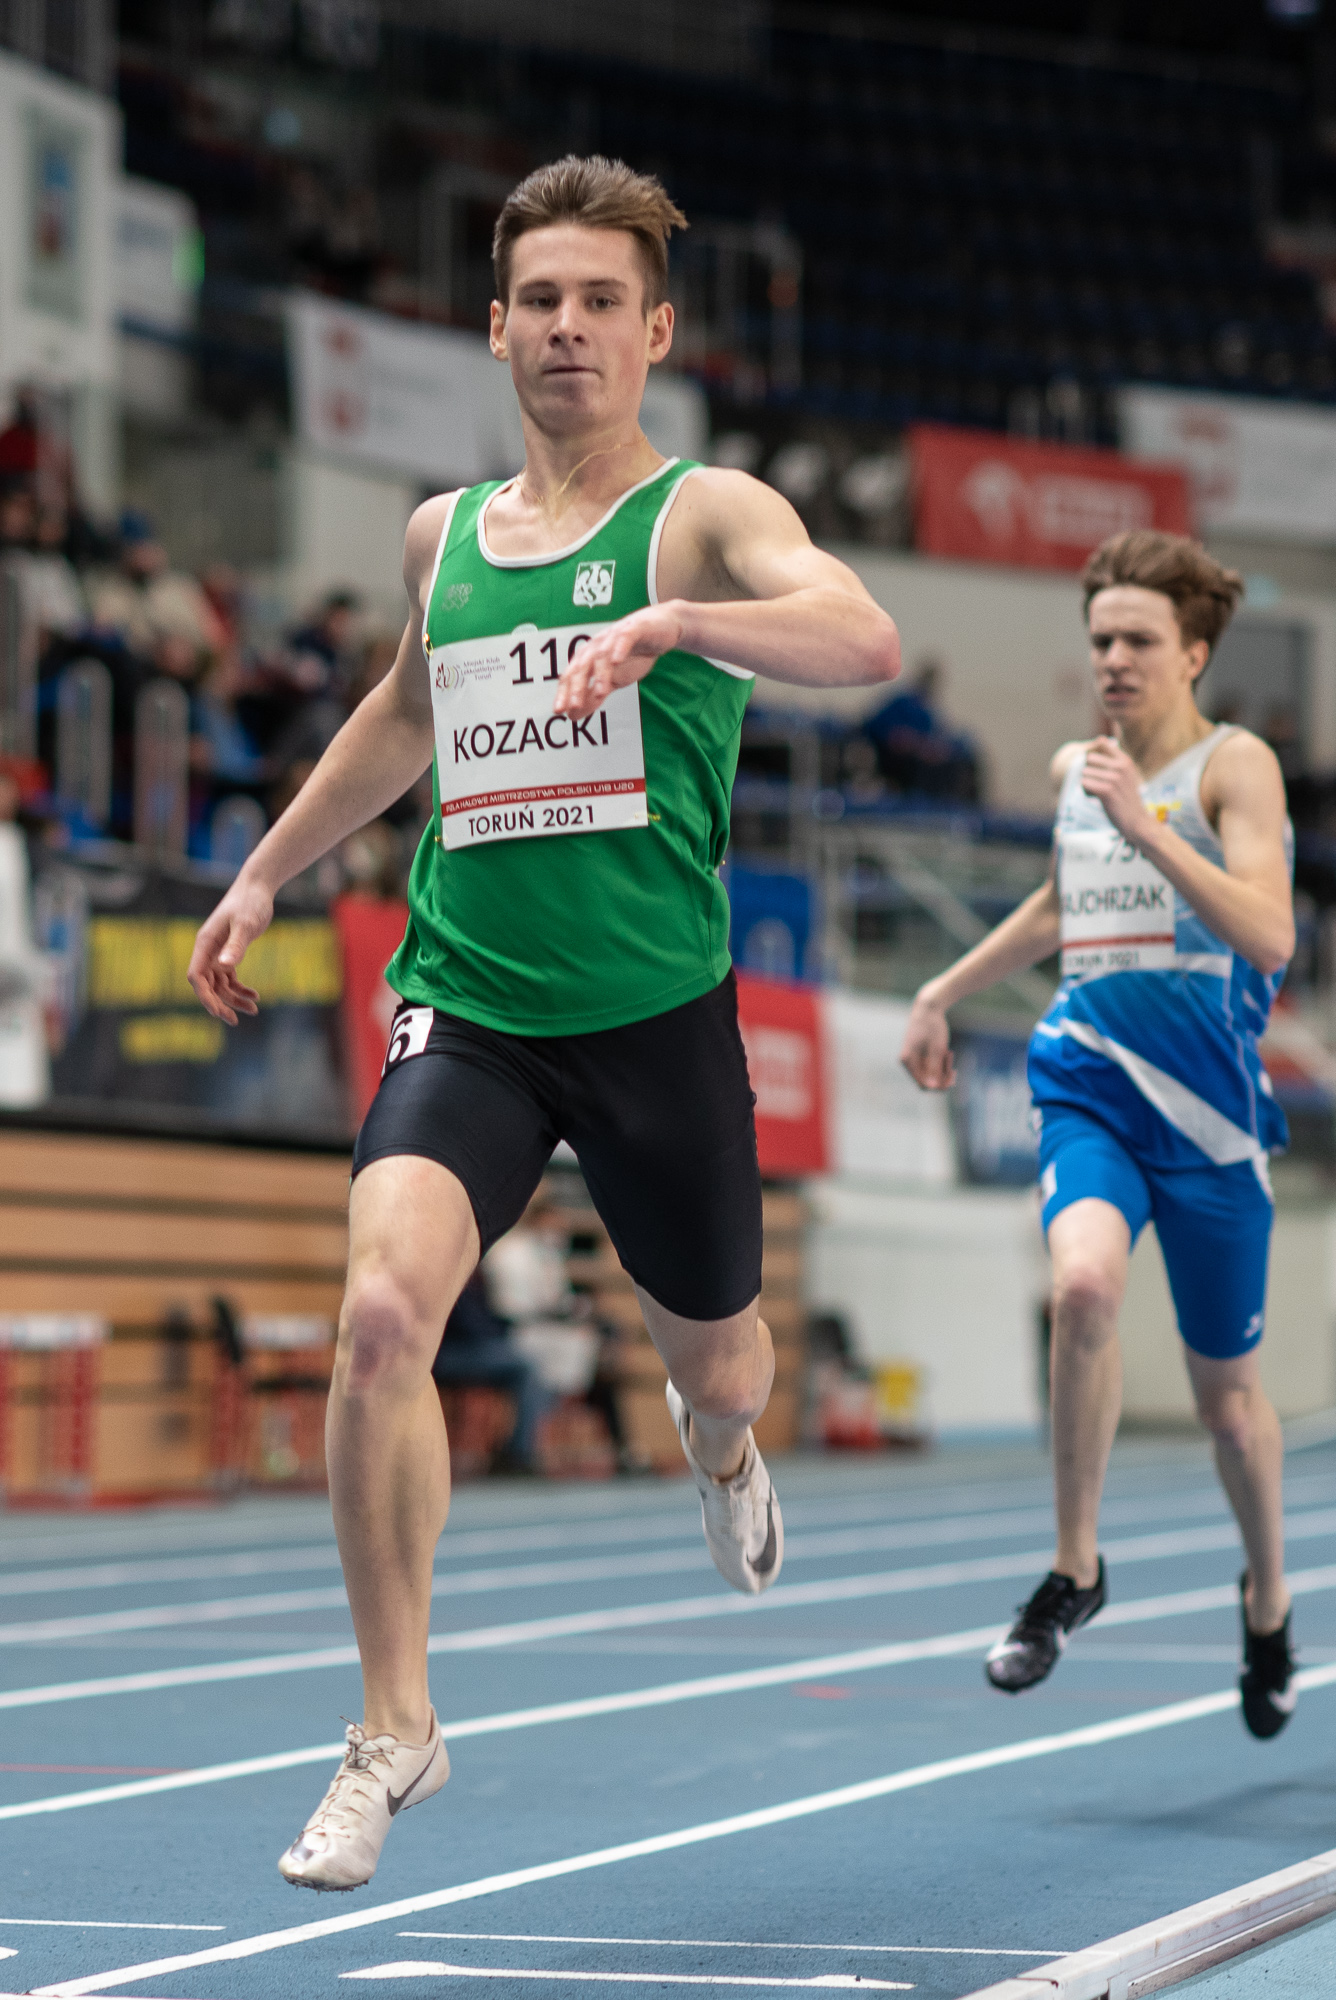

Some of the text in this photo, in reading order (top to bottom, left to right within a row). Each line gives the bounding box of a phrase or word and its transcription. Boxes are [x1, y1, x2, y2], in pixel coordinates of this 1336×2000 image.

[453, 711, 610, 764] KOZACKI
[460, 795, 488, 809] HALOWE
[489, 788, 556, 803] MISTRZOSTWA
[557, 784, 592, 796] POLSKI
[613, 781, 635, 792] U20
[468, 803, 594, 837] TORUŃ 2021
